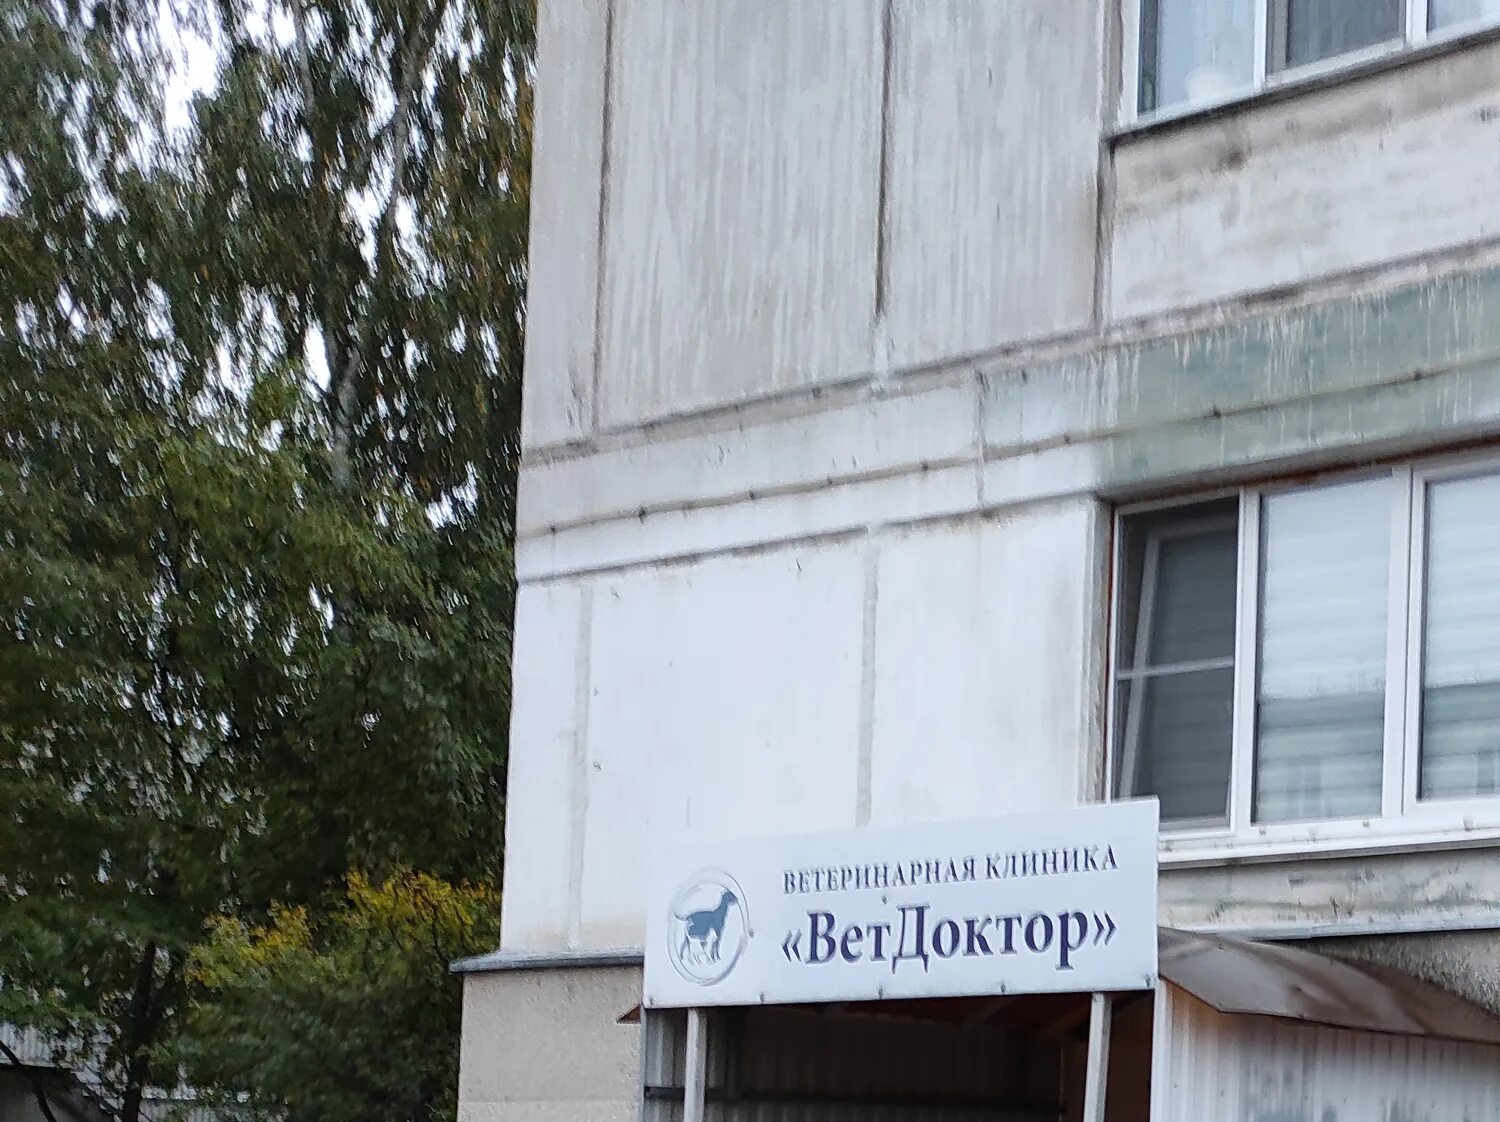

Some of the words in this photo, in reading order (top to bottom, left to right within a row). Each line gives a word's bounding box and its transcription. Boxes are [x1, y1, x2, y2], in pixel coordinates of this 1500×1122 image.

[783, 856, 977, 895] ВЕТЕРИНАРНАЯ
[985, 843, 1120, 881] КЛИНИКА
[781, 902, 1118, 975] «ВетДоктор»
